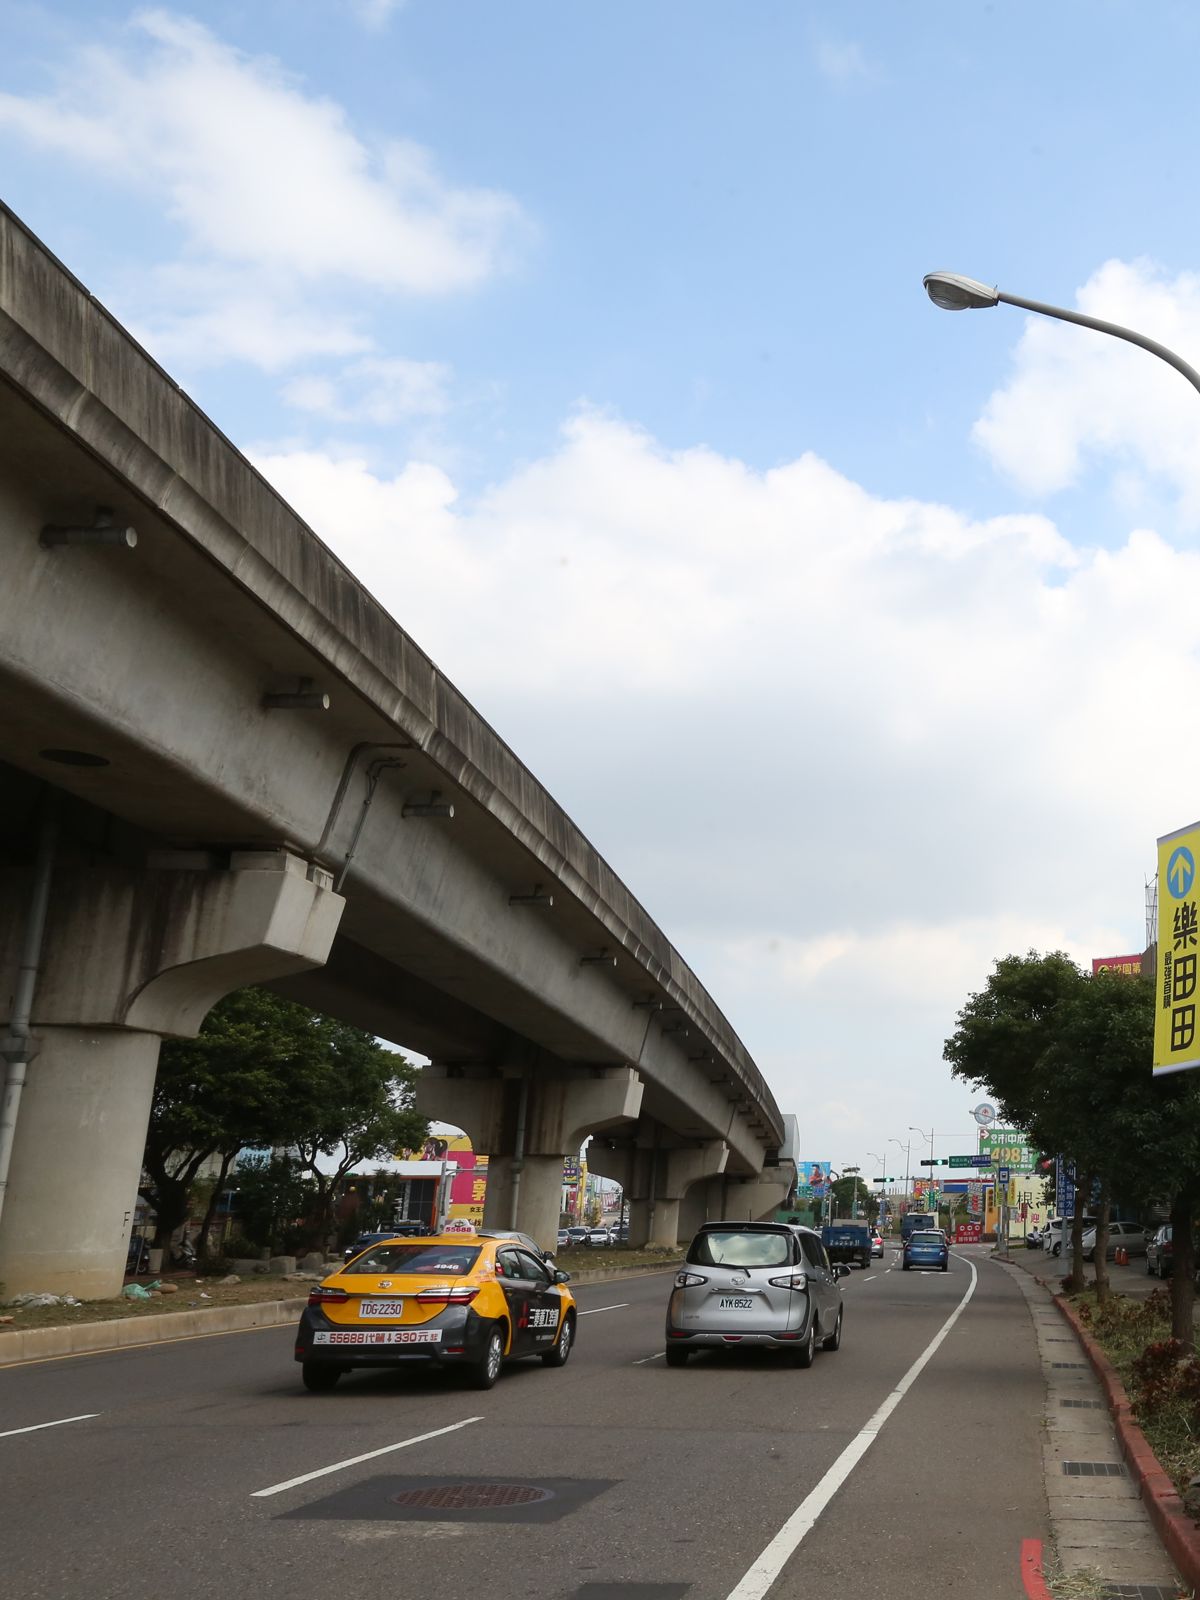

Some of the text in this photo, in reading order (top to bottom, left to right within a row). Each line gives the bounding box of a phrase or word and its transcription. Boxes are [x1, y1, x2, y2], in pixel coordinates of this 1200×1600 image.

[1170, 901, 1198, 1051] 樂田田
[361, 1303, 402, 1315] TDG-2230
